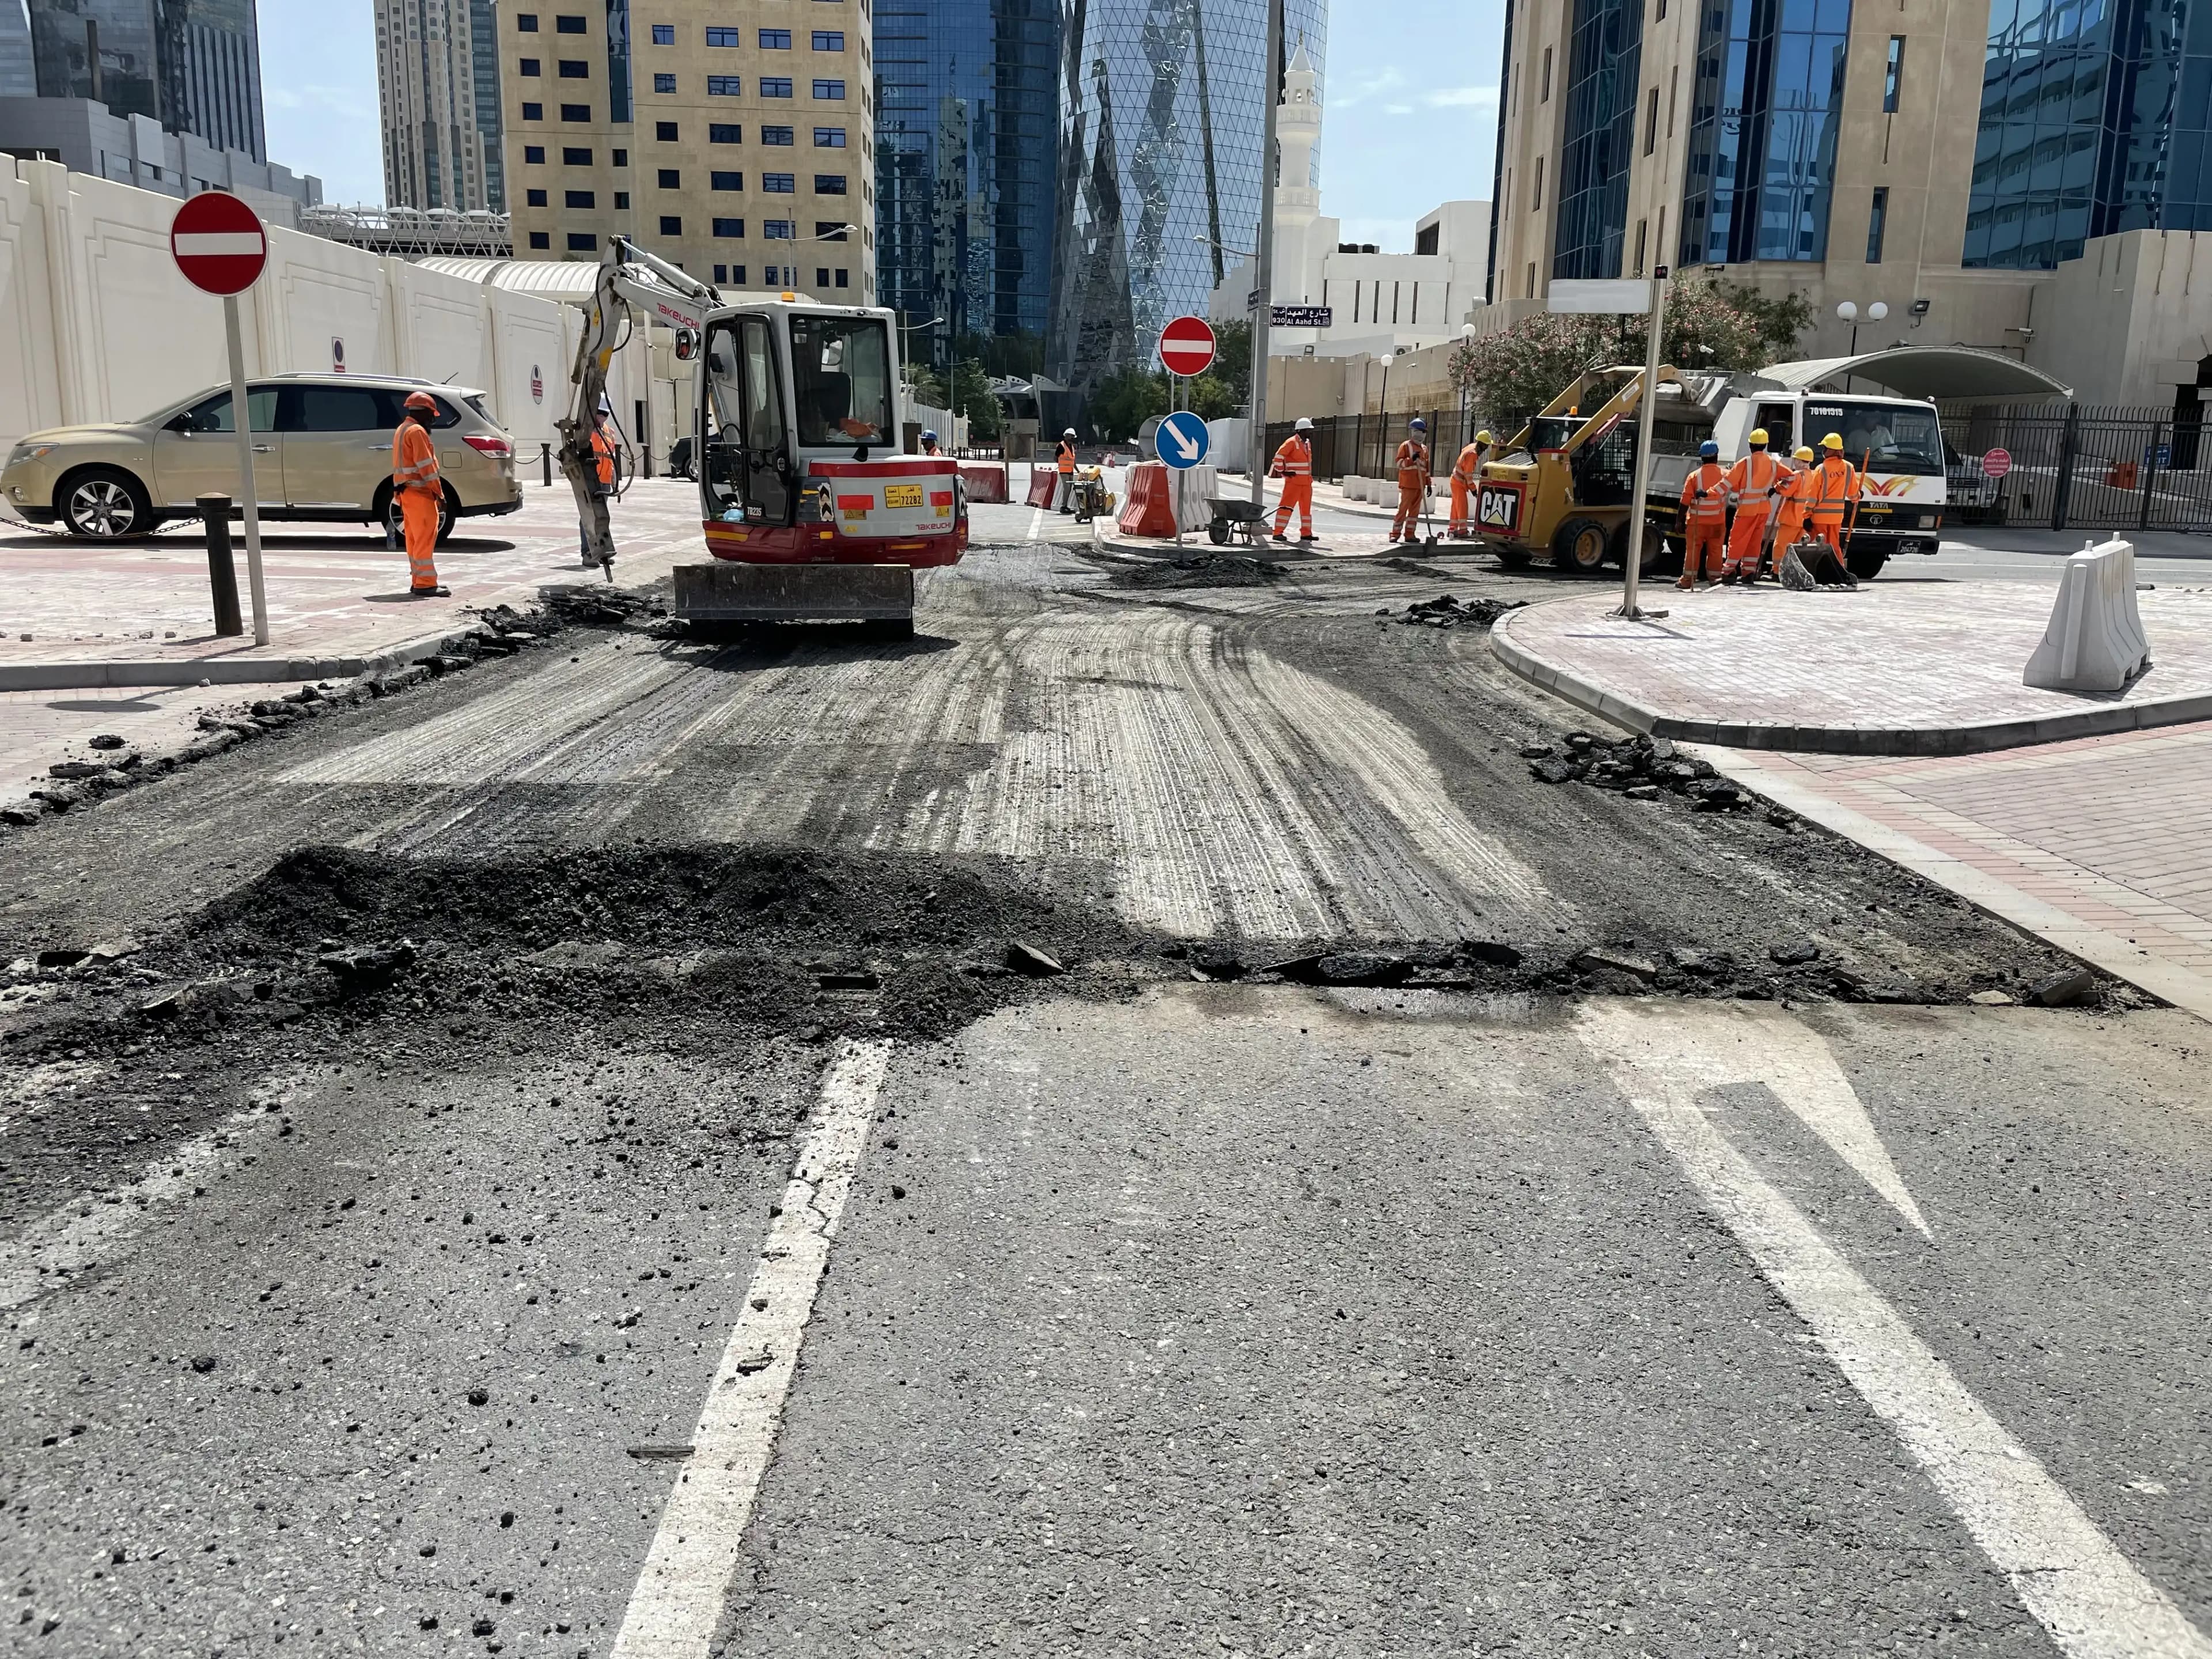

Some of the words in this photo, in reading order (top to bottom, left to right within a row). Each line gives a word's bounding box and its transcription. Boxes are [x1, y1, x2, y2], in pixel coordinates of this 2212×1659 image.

[1287, 309, 1307, 317] العهد
[1309, 309, 1328, 318] شارع
[901, 495, 922, 505] 72282
[1480, 491, 1516, 526] CAT
